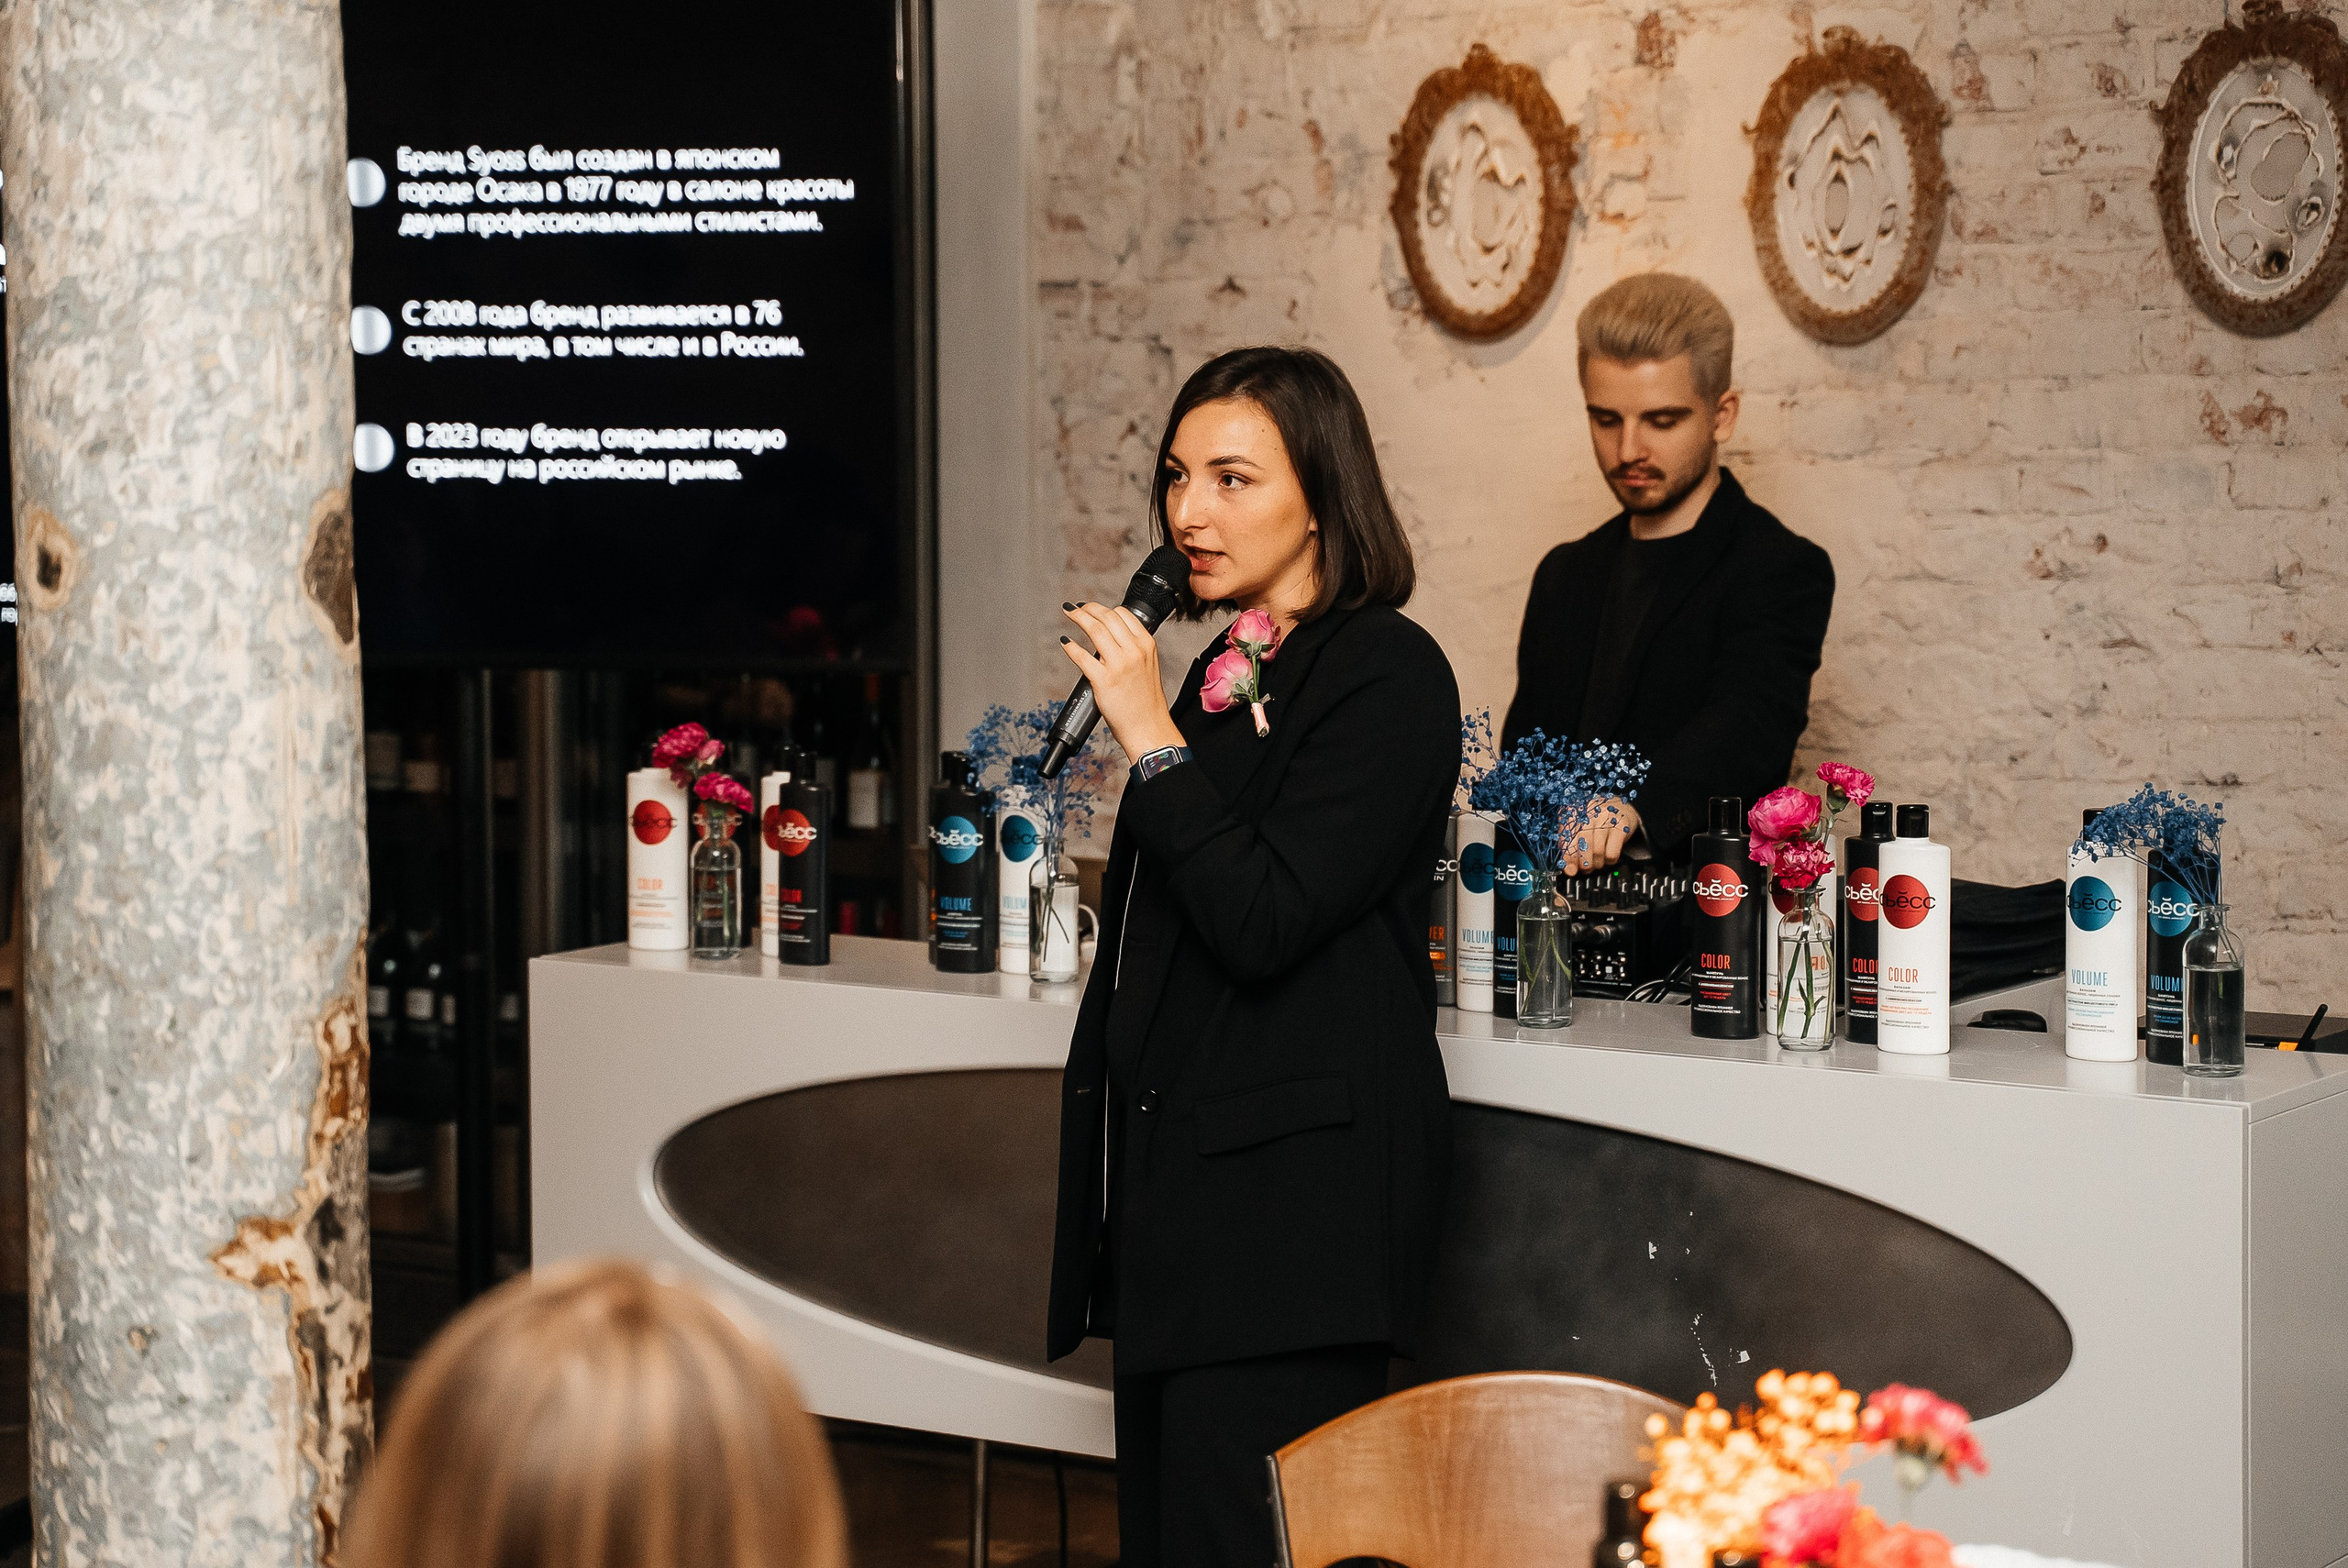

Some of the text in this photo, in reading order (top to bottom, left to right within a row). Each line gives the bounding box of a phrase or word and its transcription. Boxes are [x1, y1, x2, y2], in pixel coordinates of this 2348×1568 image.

[397, 144, 780, 177] Бренд Syoss был создан в японском
[398, 176, 854, 207] городе Осака в 1977 году в салоне красоты
[479, 304, 528, 328] года
[530, 300, 599, 331] бренд
[601, 304, 732, 331] развивается
[735, 304, 750, 326] в
[752, 299, 782, 326] 76
[403, 336, 486, 361] странах
[553, 336, 570, 357] в
[570, 336, 613, 357] том
[615, 336, 680, 358] числе
[682, 336, 700, 357] и
[703, 336, 718, 357] в
[406, 422, 787, 455] В 2023 году бренд открывает новую
[406, 458, 505, 485] страницу
[507, 458, 537, 479] на
[538, 454, 666, 485] российском
[940, 896, 972, 911] VOLUME
[1700, 953, 1731, 969] COLOR
[1888, 966, 1919, 983] COLOR
[2071, 968, 2108, 987] VOLUME
